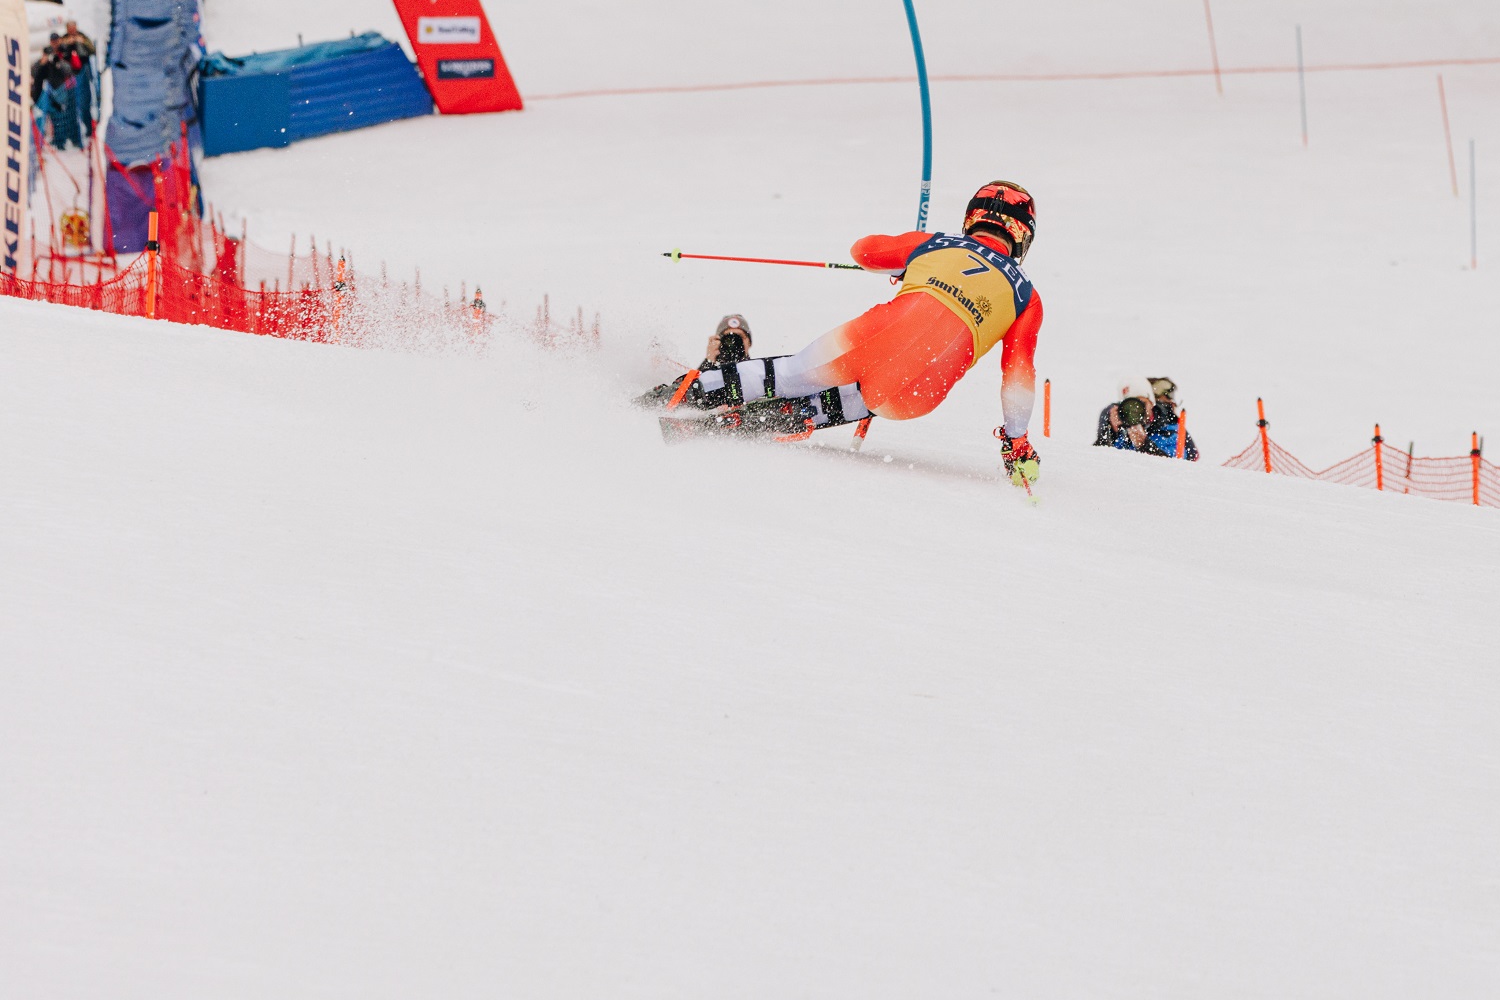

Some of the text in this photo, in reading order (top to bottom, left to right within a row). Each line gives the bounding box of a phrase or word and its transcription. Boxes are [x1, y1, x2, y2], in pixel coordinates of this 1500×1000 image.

[4, 35, 22, 280] KECHERS
[927, 236, 1025, 303] STIFEL
[960, 253, 992, 277] 7
[926, 276, 985, 327] SunValley
